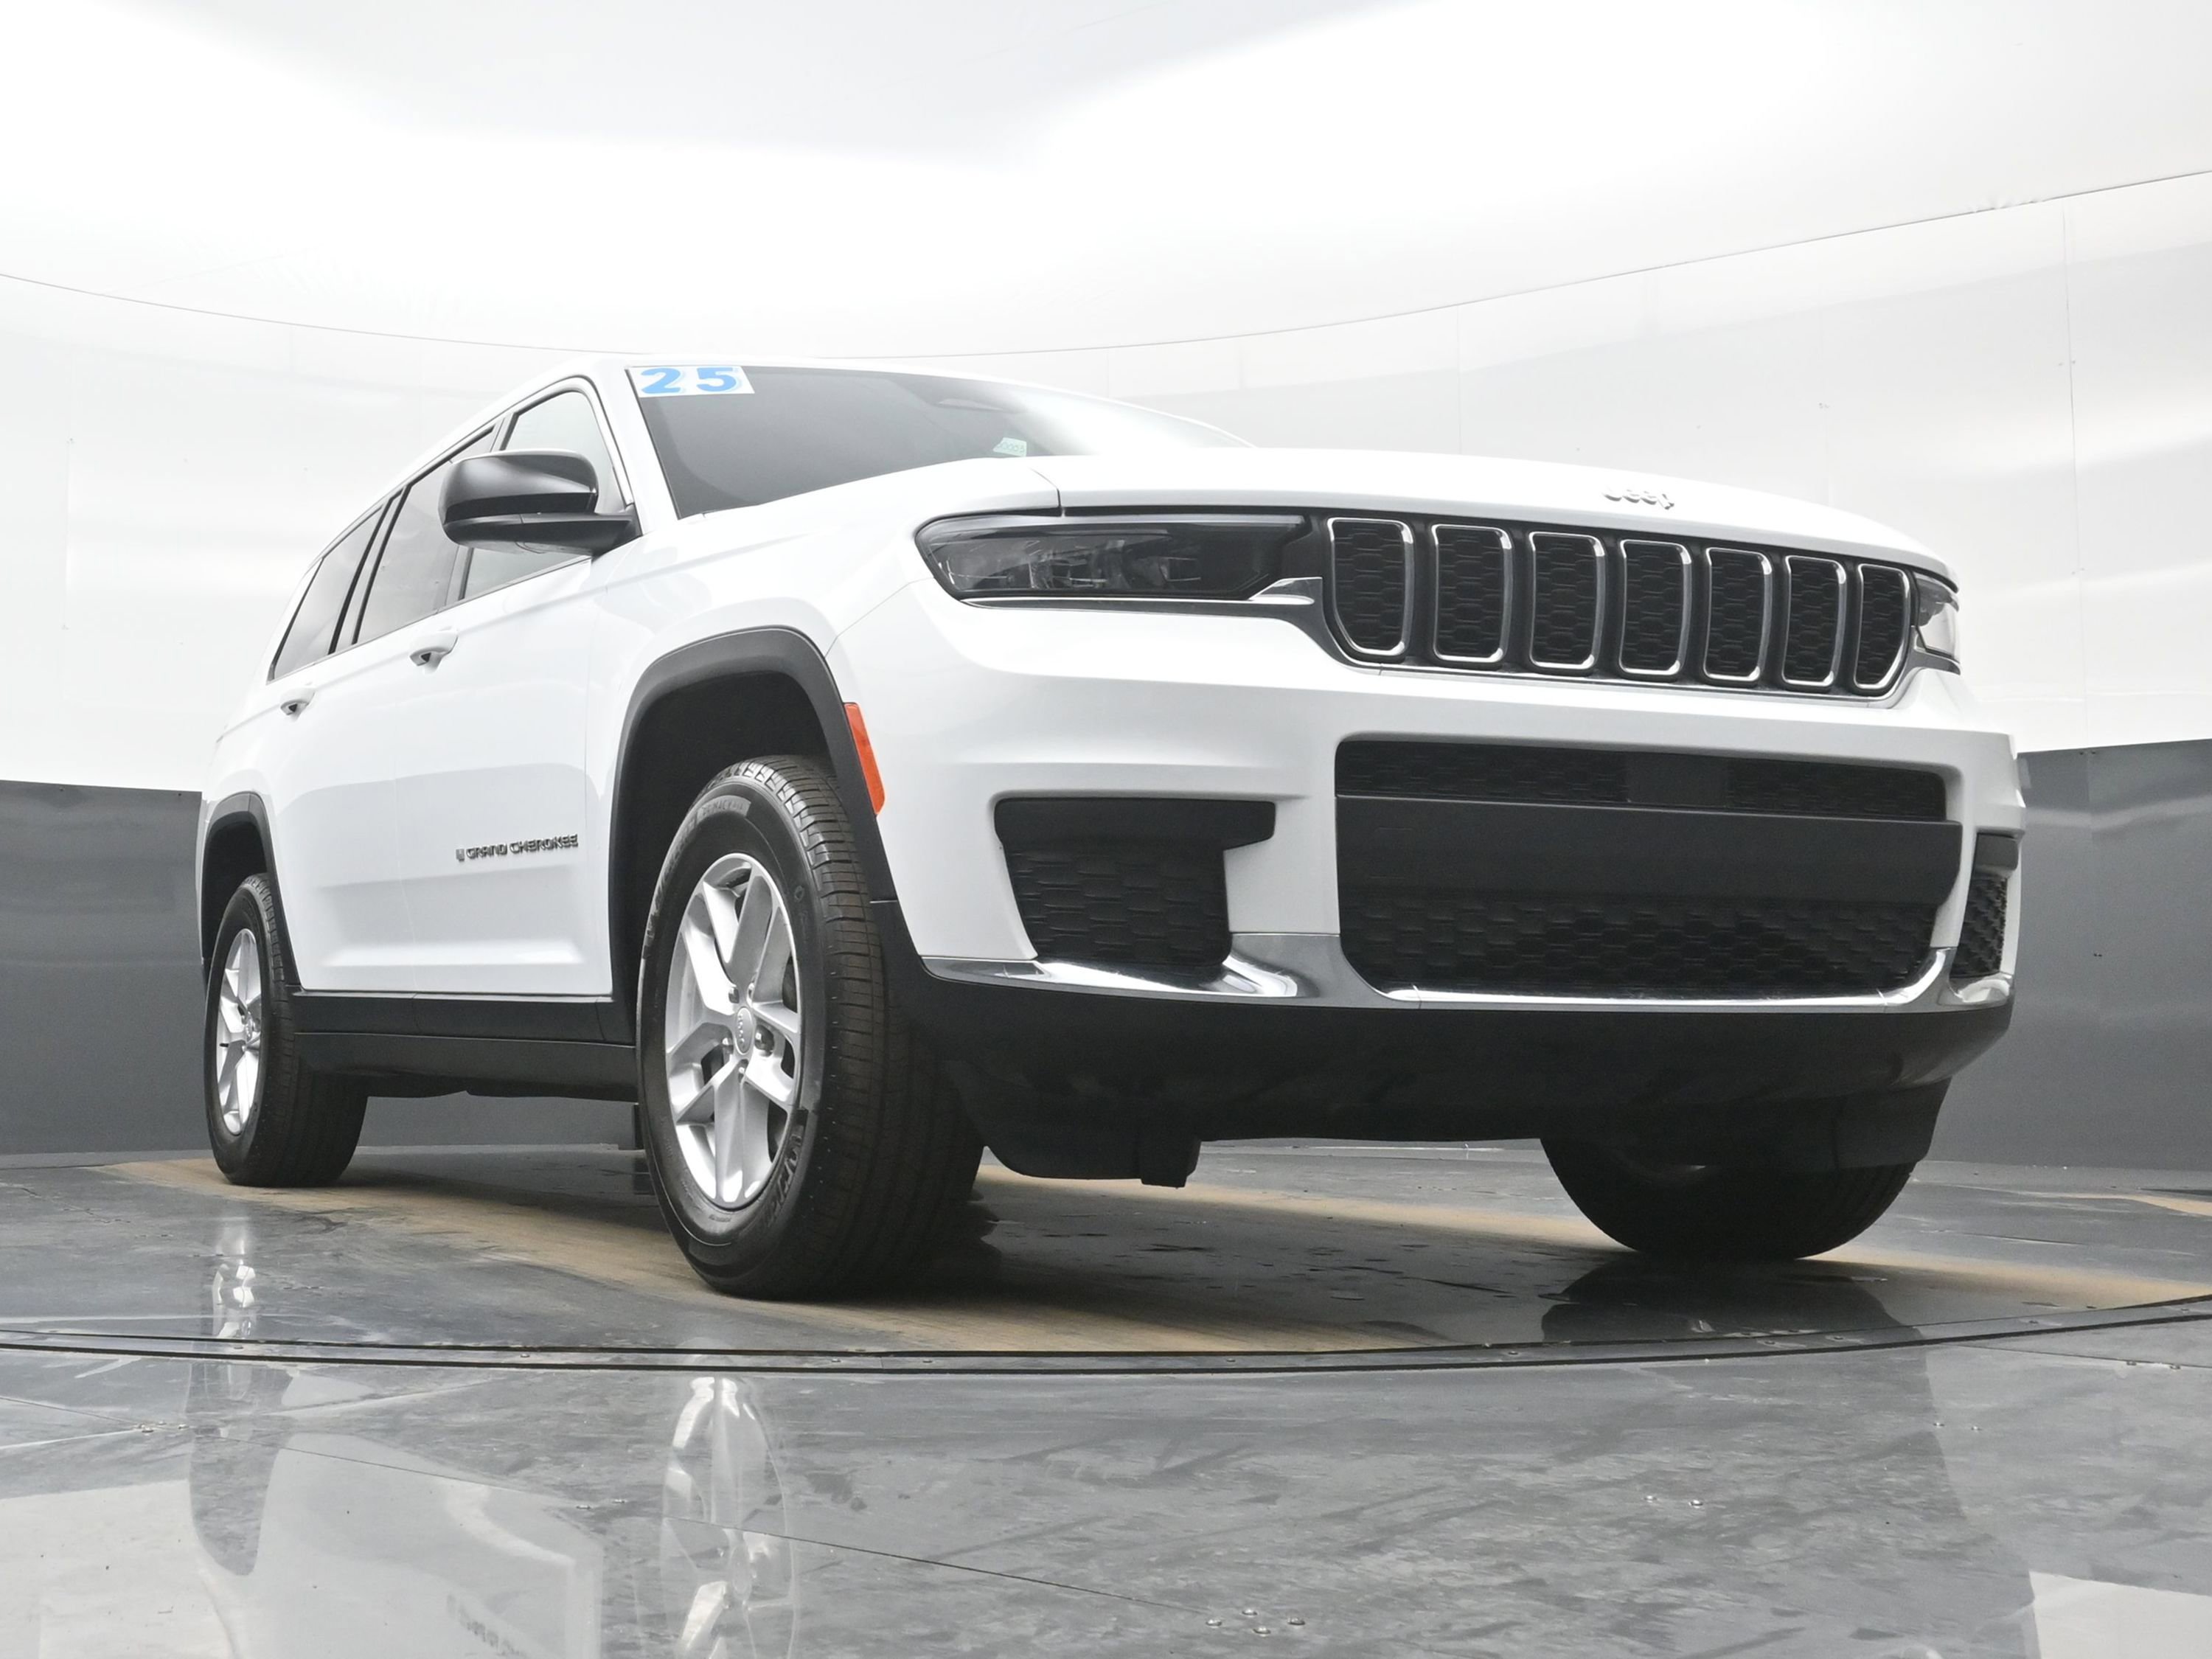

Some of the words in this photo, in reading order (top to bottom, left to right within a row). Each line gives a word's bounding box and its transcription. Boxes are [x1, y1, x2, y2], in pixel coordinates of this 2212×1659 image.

[640, 366, 738, 394] 25
[466, 844, 507, 860] GRAND
[509, 834, 579, 854] CHEROKEE
